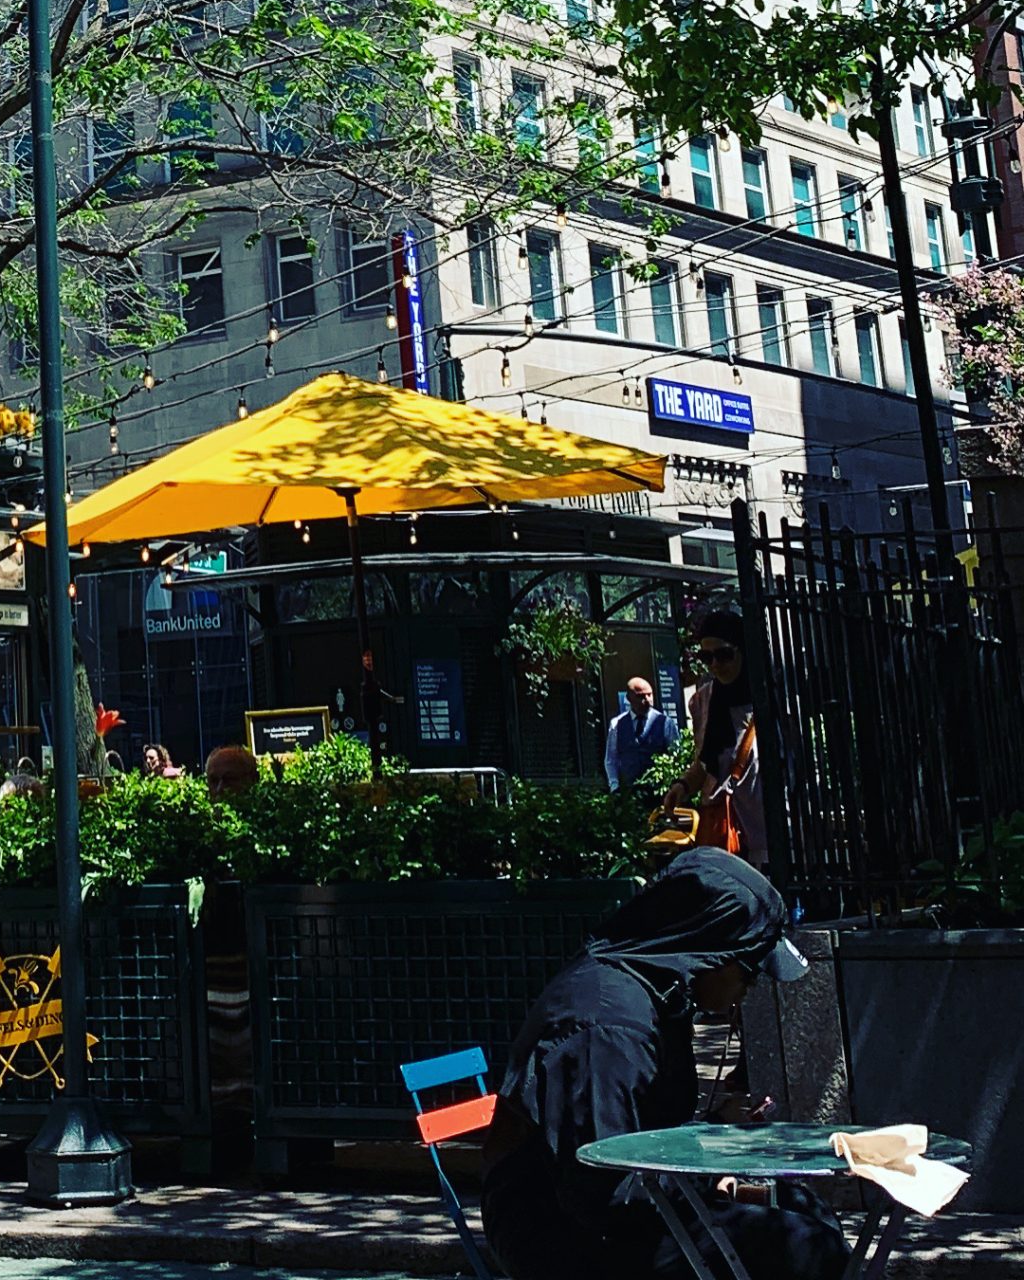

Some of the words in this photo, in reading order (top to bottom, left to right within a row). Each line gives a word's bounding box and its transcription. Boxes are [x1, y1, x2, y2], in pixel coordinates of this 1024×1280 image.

[655, 384, 685, 416] THE
[685, 389, 724, 423] YARD
[146, 612, 221, 633] BankUnited
